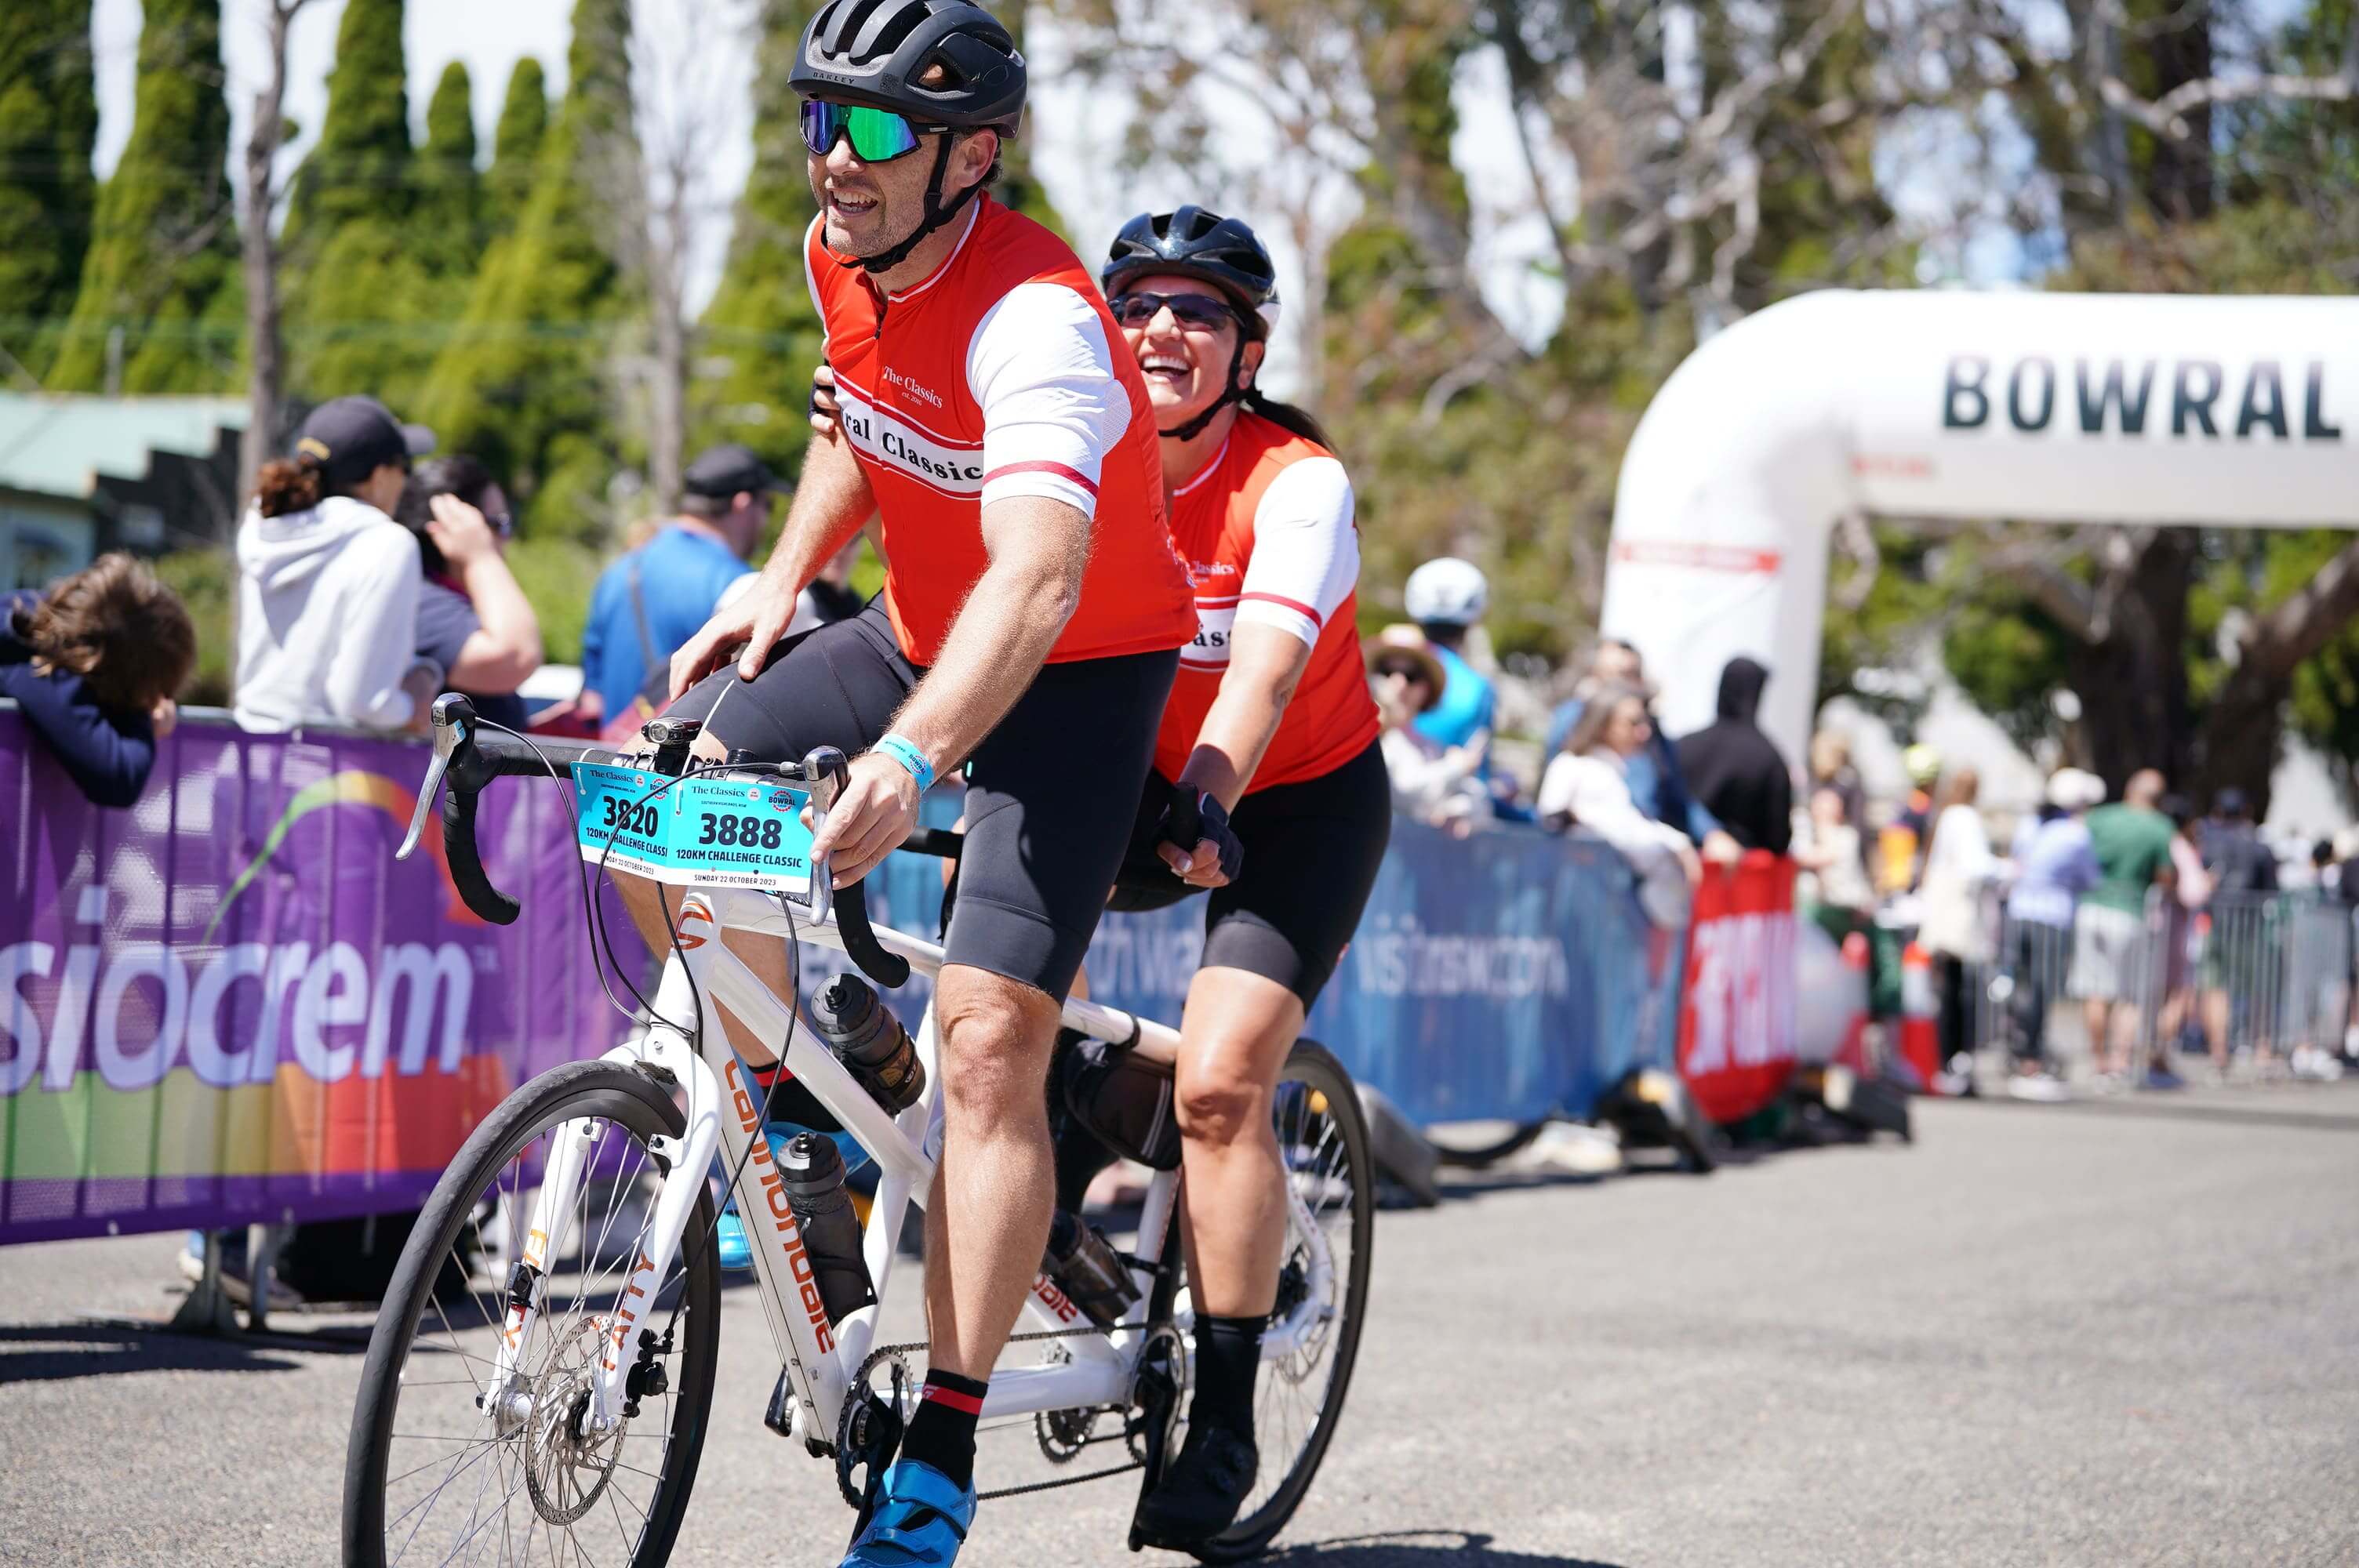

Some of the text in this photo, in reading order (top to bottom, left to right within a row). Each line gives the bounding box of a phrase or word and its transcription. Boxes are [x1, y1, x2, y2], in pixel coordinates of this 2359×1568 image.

[812, 71, 856, 85] OAKLEY
[883, 365, 943, 409] The Classics
[1942, 353, 2343, 441] BOWRAL
[845, 412, 984, 481] ral Classic
[589, 769, 606, 779] The
[605, 771, 634, 783] Classics
[691, 786, 709, 795] The
[710, 787, 746, 797] Classics
[603, 795, 659, 838] 3820
[768, 795, 797, 807] BOWRAL
[586, 826, 668, 858] 120KM HALLENGE CLASSI
[698, 812, 783, 850] 3888
[676, 848, 803, 869] 120KM CHALLENGE CLASSIC
[729, 877, 758, 885] OCTOBER
[0, 884, 471, 1091] siocrem
